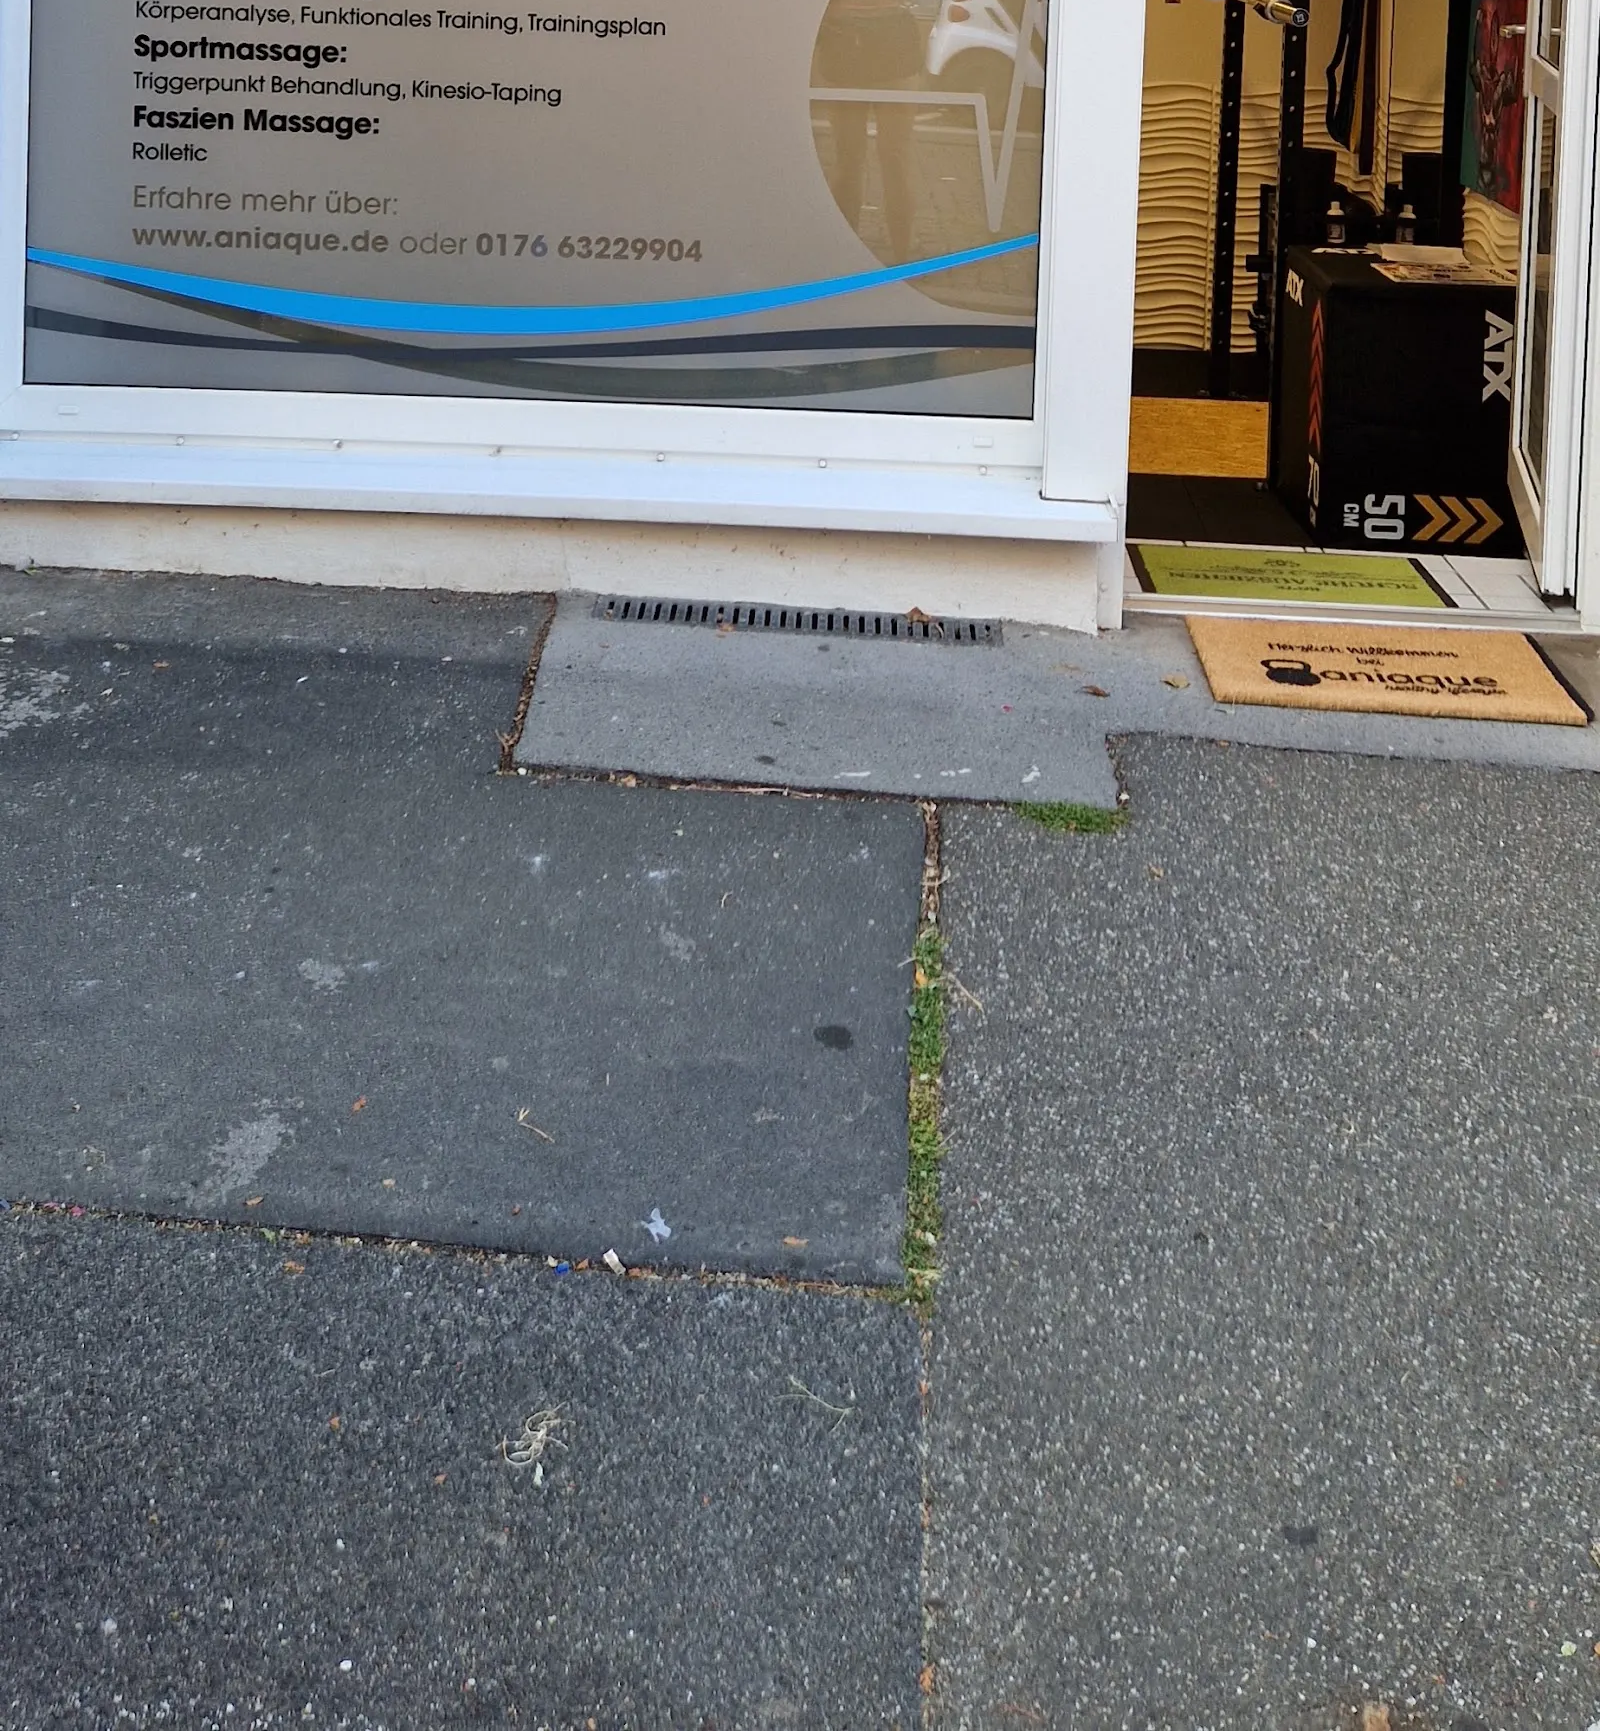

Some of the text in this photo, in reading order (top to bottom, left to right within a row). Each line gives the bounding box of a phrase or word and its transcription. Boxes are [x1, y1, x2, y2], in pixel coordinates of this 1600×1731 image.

[135, 1, 666, 38] Körperanalyse, Funktionales Training, Trainingsplan
[134, 34, 347, 69] Sportmassage:
[134, 72, 562, 107] Triggerpunkt Behandlung, Kinesio-Taping
[133, 105, 380, 140] Faszien Massage:
[132, 142, 208, 162] Rolletic
[133, 185, 399, 215] Erfahre mehr über:
[132, 227, 702, 262] www.aniaque.de oder 0176 63229904
[1286, 268, 1303, 307] ATX
[1482, 310, 1513, 403] ATX
[1343, 503, 1359, 528] CM
[1364, 494, 1406, 540] 50
[1268, 642, 1459, 658] Herzlich Willkommen
[1319, 668, 1498, 689] aniaque
